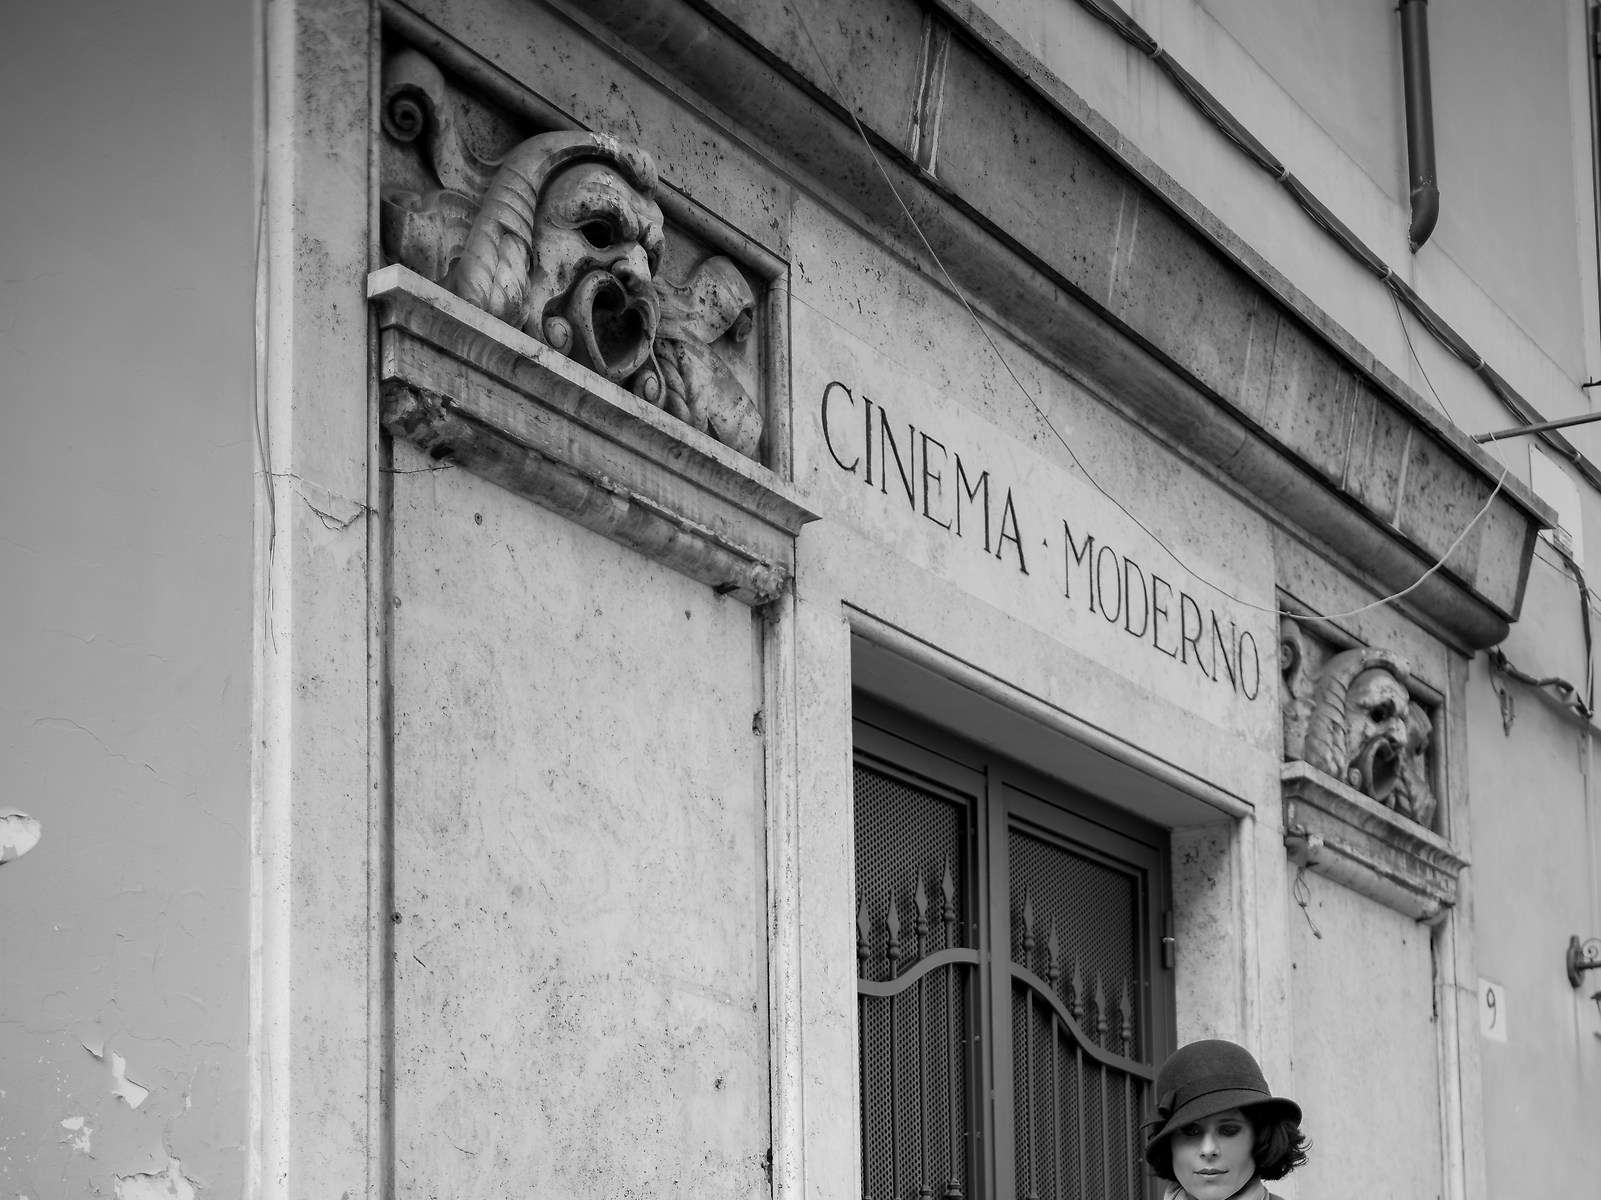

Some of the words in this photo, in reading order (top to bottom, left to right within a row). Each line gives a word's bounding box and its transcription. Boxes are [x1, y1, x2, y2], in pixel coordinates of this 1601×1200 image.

[821, 380, 1029, 576] CINEMA
[1063, 518, 1260, 701] MODERNO
[1486, 987, 1497, 1030] 9
